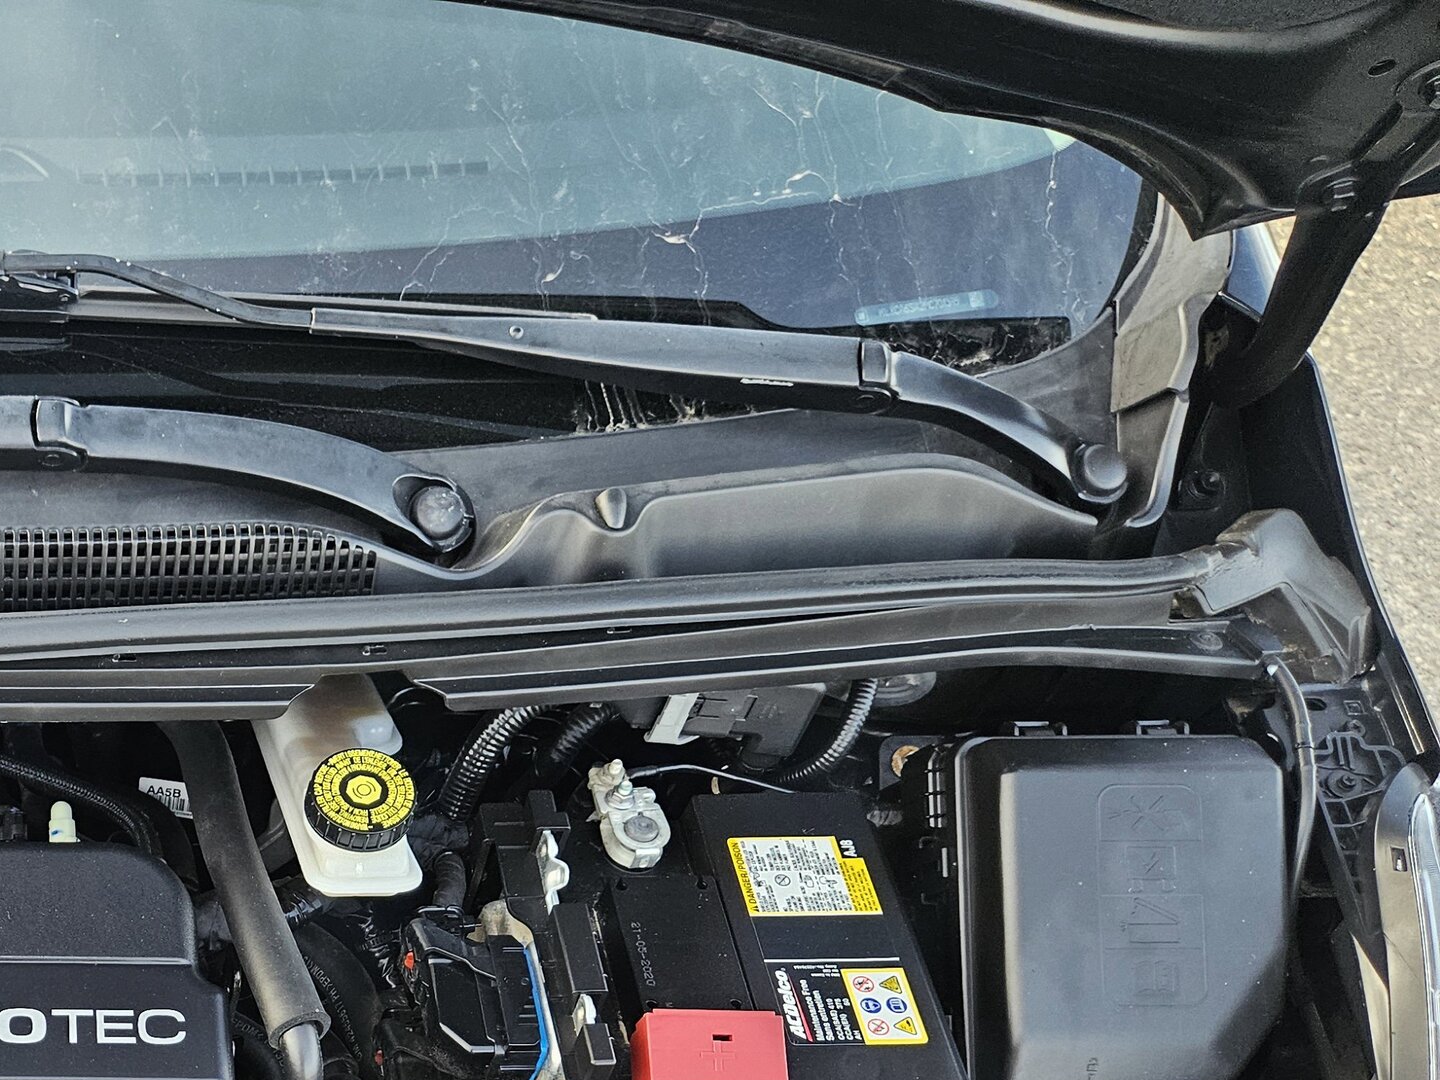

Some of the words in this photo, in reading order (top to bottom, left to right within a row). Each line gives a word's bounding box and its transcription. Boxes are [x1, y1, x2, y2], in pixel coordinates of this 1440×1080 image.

[146, 785, 181, 798] AA5B
[840, 839, 858, 858] AJ8
[731, 842, 760, 906] DANGER/POISON
[800, 979, 811, 996] Free
[774, 969, 807, 1040] ACDelco
[805, 996, 826, 1041] Maintenance
[822, 1022, 835, 1041] Sans
